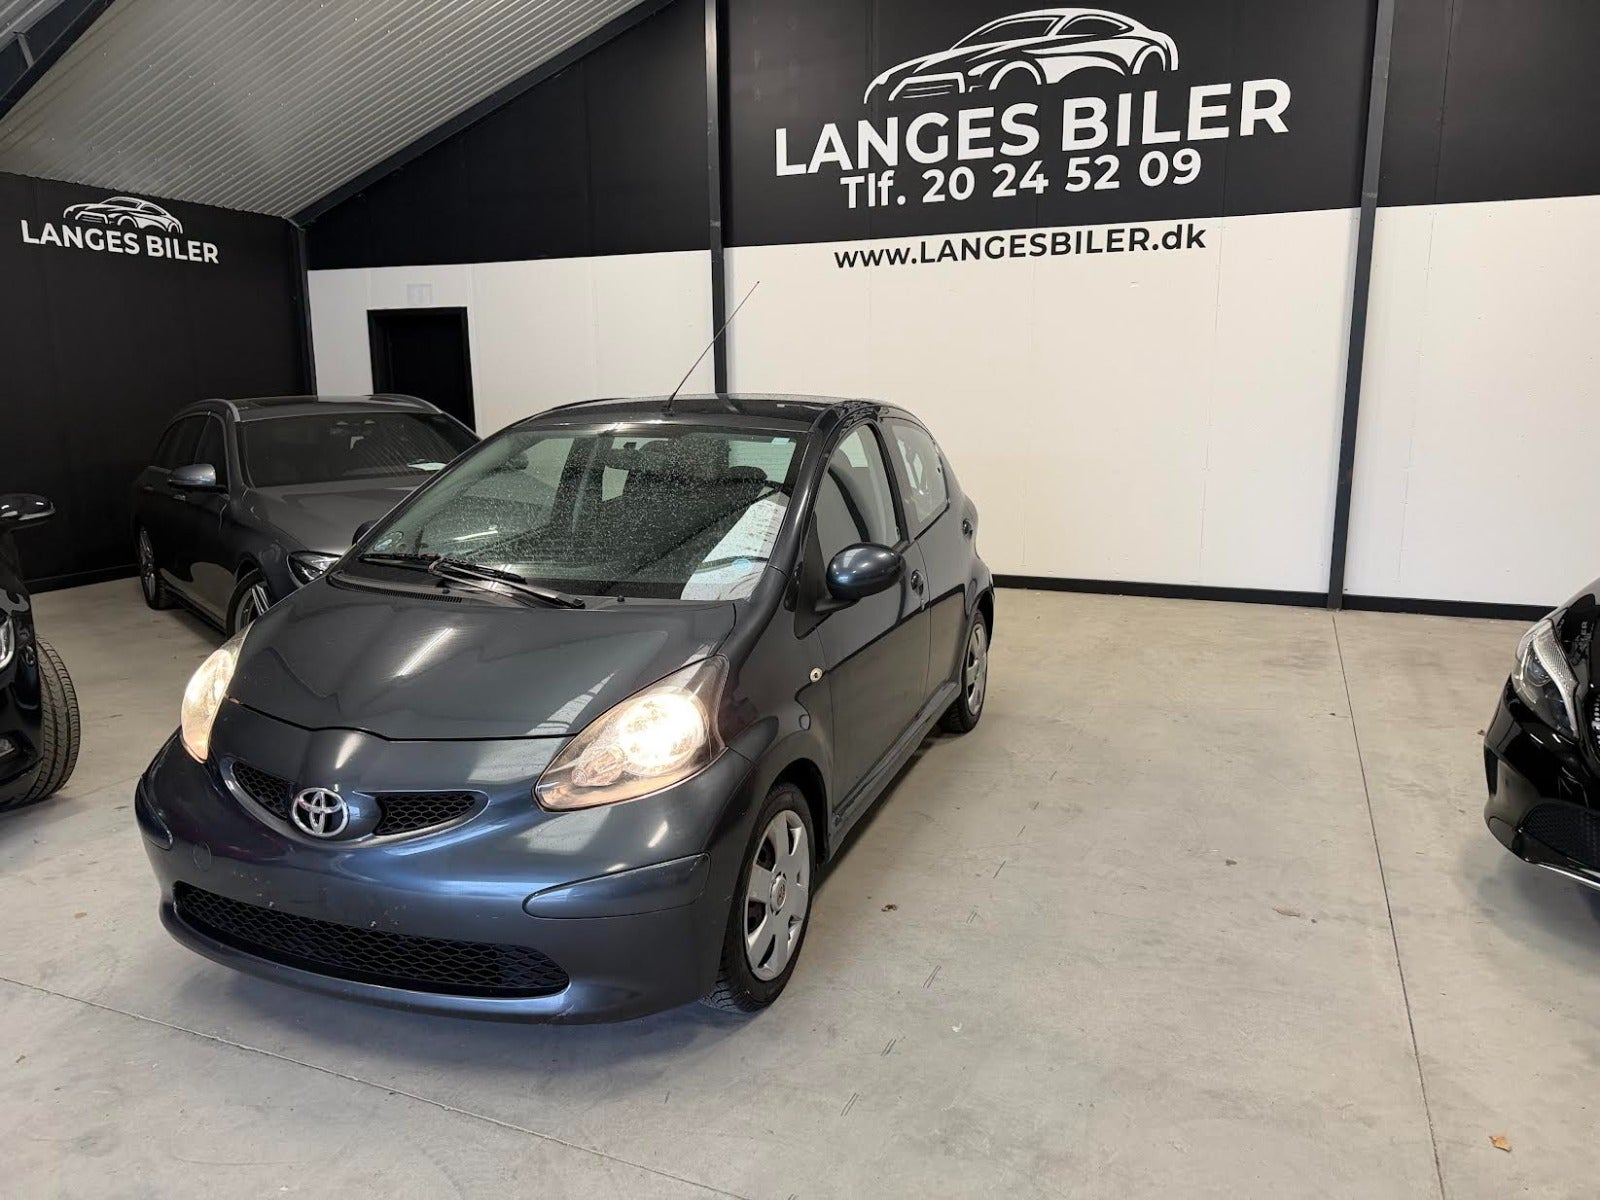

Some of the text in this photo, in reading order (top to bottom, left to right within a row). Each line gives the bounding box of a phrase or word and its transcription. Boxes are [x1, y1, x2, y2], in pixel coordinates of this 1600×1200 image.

[775, 78, 1291, 177] LANGES BILER
[839, 147, 1202, 208] Tlf. 20 24 52 09
[20, 219, 219, 264] LANGES BILER
[834, 223, 1206, 269] www.LANGESBILER.dk
